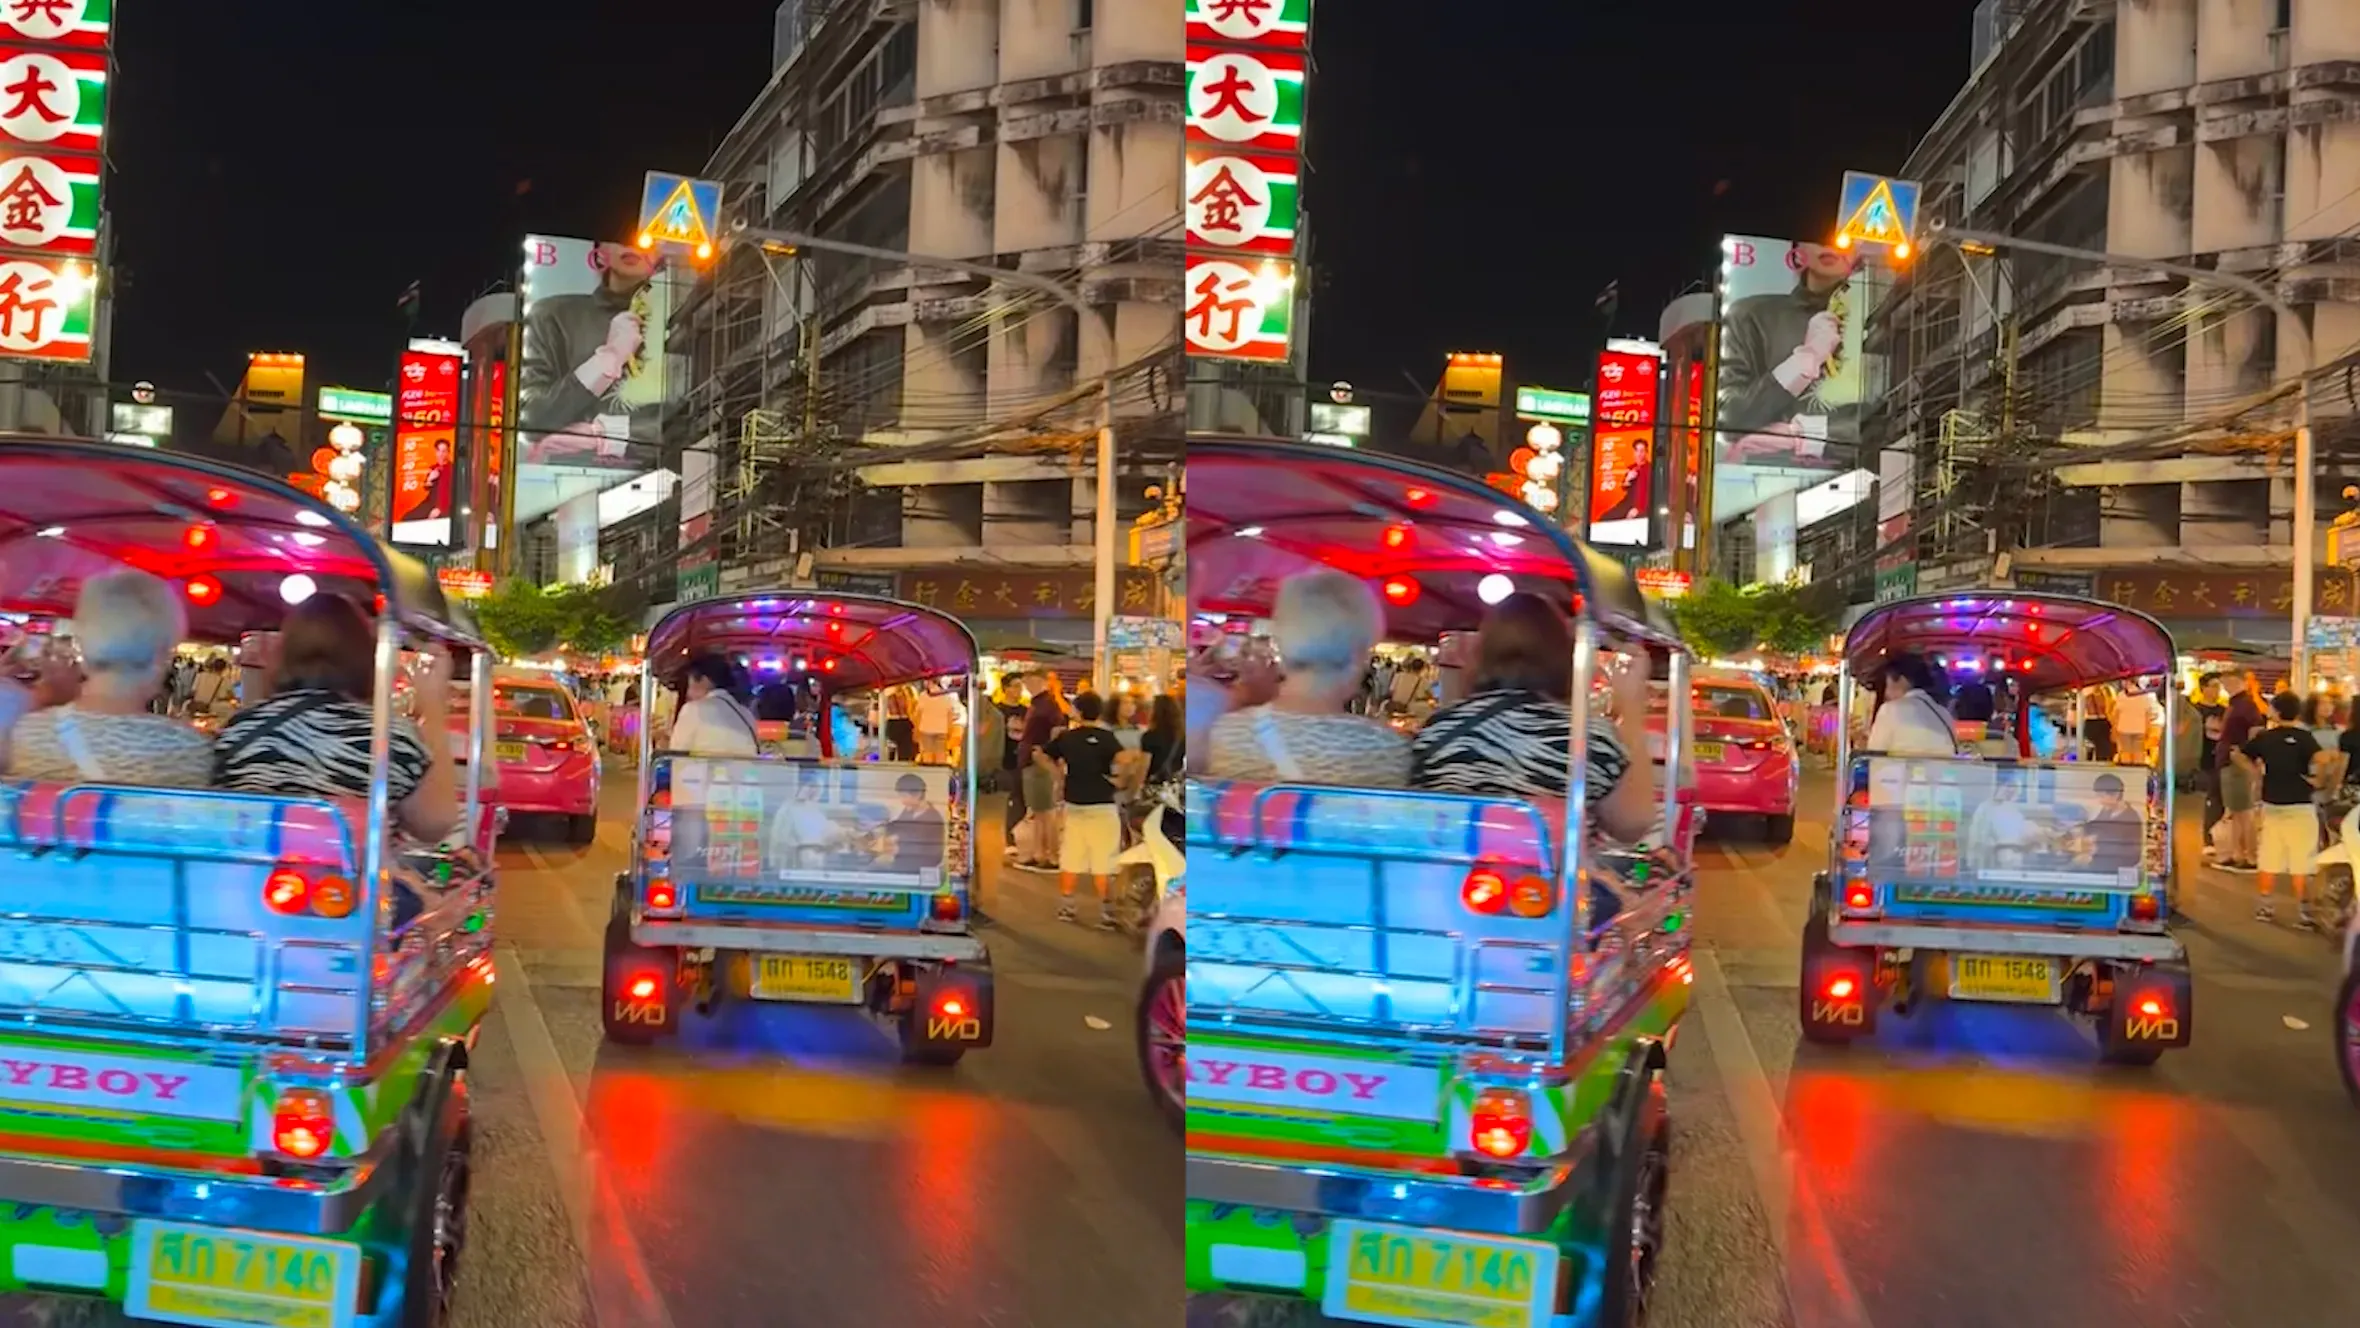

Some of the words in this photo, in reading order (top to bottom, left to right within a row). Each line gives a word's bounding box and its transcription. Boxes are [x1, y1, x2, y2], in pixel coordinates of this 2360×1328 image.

[806, 960, 849, 981] 1548
[2004, 960, 2046, 981] 1548
[0, 1058, 190, 1100] YBOY
[232, 1241, 332, 1293] 7140
[1430, 1241, 1530, 1293] 7140
